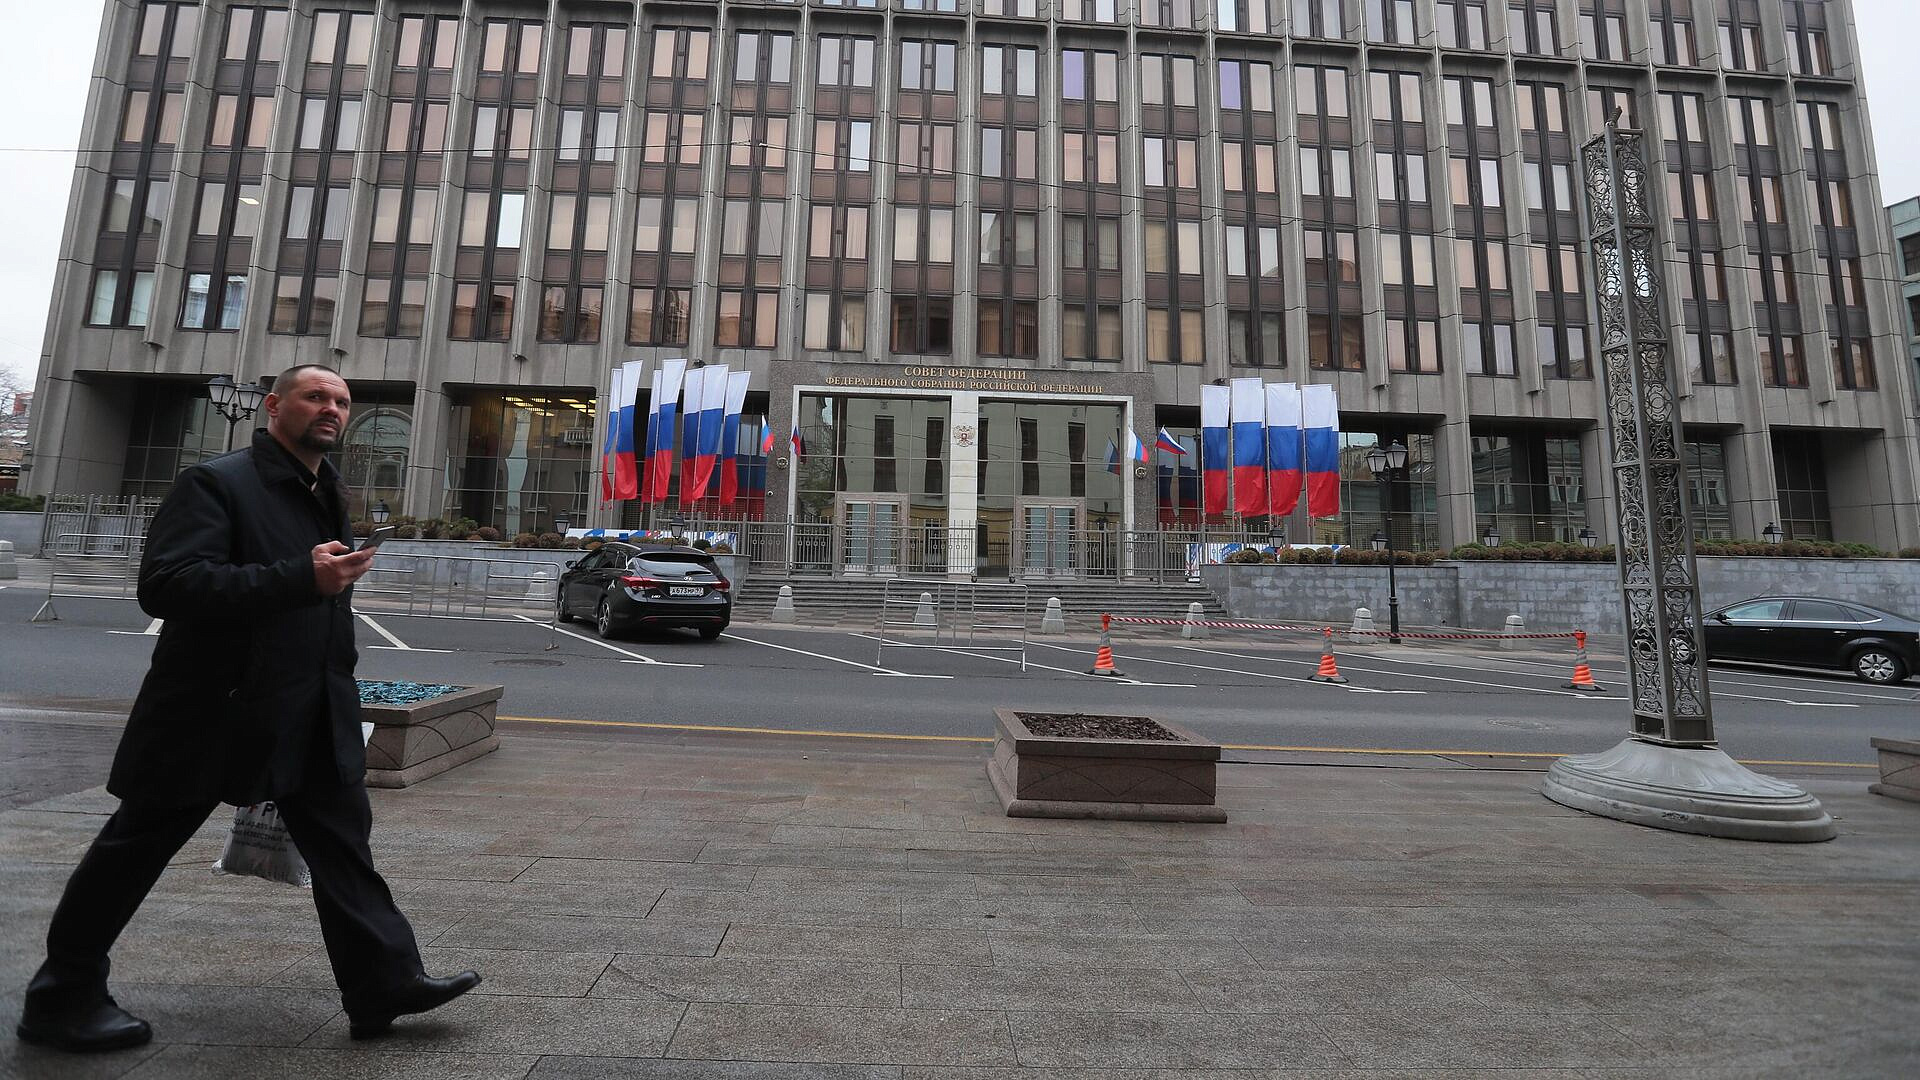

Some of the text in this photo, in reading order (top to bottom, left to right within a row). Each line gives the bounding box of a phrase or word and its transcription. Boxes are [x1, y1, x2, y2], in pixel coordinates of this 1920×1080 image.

[904, 366, 1026, 380] СОВЕТ ФЕДЕРАЦИИ
[825, 376, 1103, 394] ФЕДЕРАЛЬНОГО СОБРАНИЯ РОССИЙСКОЙ ФЕДЕРАЦИИ
